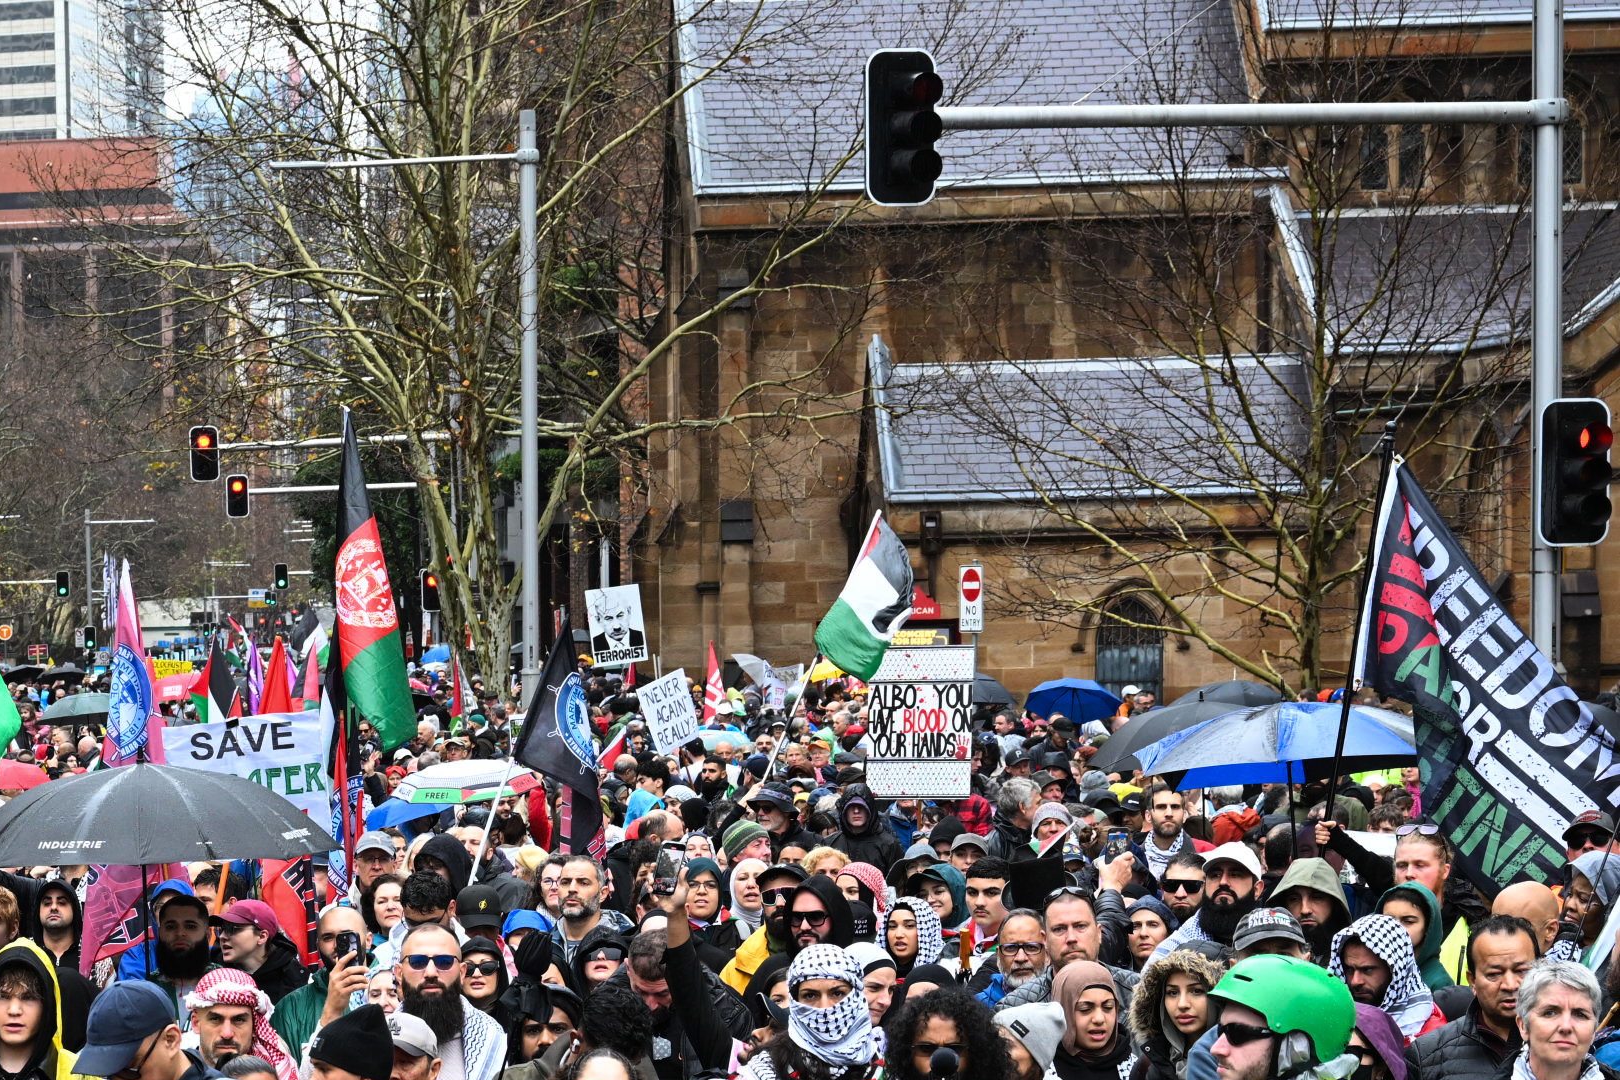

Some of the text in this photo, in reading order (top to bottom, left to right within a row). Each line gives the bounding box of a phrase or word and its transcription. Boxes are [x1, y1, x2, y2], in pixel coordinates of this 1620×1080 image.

[966, 605, 977, 615] NO
[961, 618, 981, 627] ENTRY
[594, 646, 645, 663] TERRORIST
[869, 683, 973, 712] ALBO, YOU
[868, 708, 973, 734] HAVE BLOOD ON
[657, 716, 696, 750] REALLY?
[190, 721, 295, 761] SAVE
[868, 732, 956, 758] YOUR HANDS
[424, 791, 450, 800] FREE!
[37, 840, 104, 850] INDUSTRIE
[1249, 909, 1271, 920] FREE
[1248, 916, 1292, 928] PALESTINE
